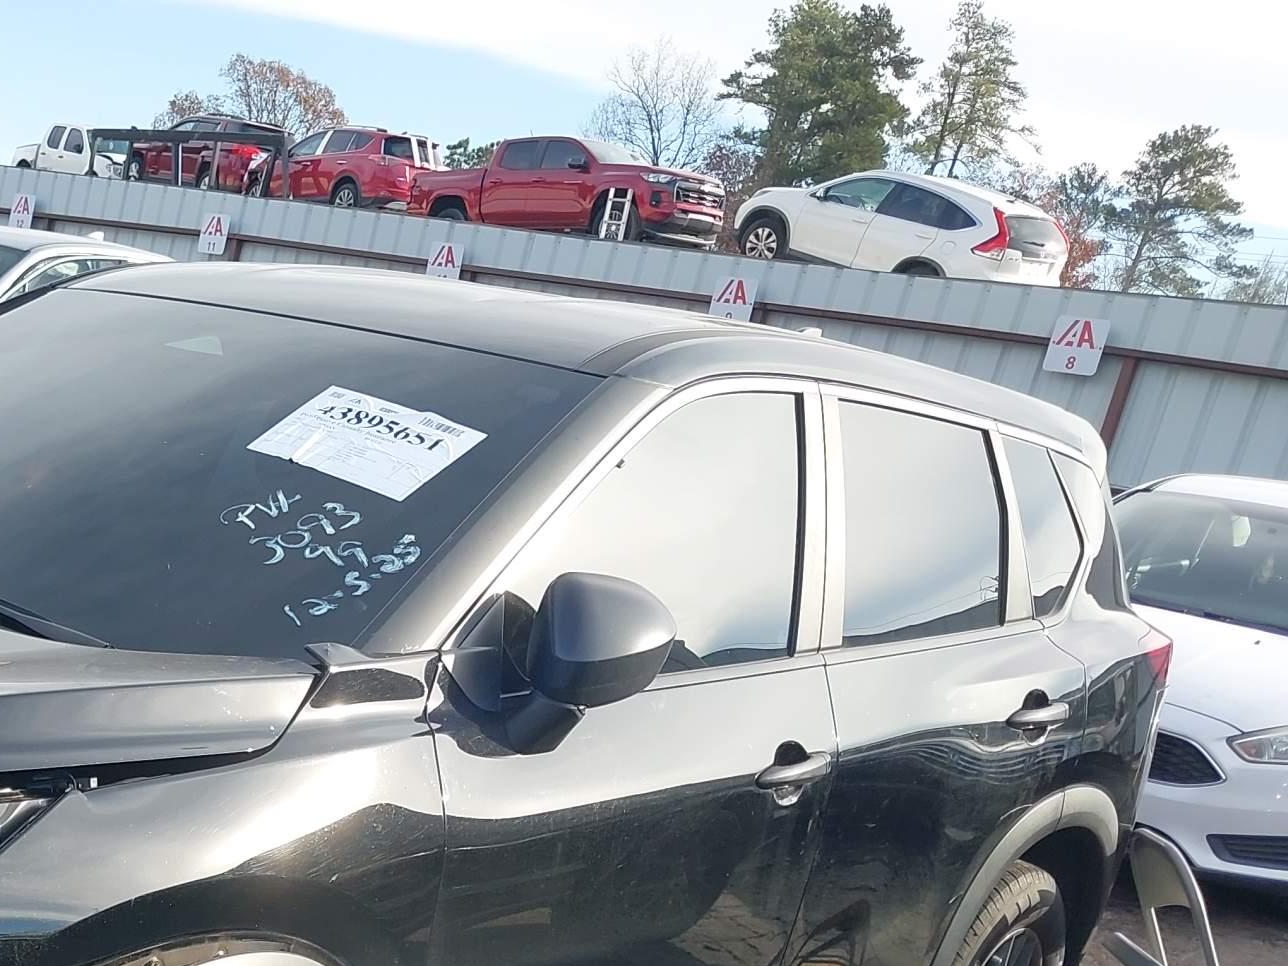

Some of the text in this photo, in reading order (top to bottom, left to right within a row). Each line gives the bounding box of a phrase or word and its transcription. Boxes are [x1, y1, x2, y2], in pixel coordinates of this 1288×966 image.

[207, 241, 216, 252] 11
[1065, 356, 1077, 370] 8
[318, 405, 446, 451] 43895651
